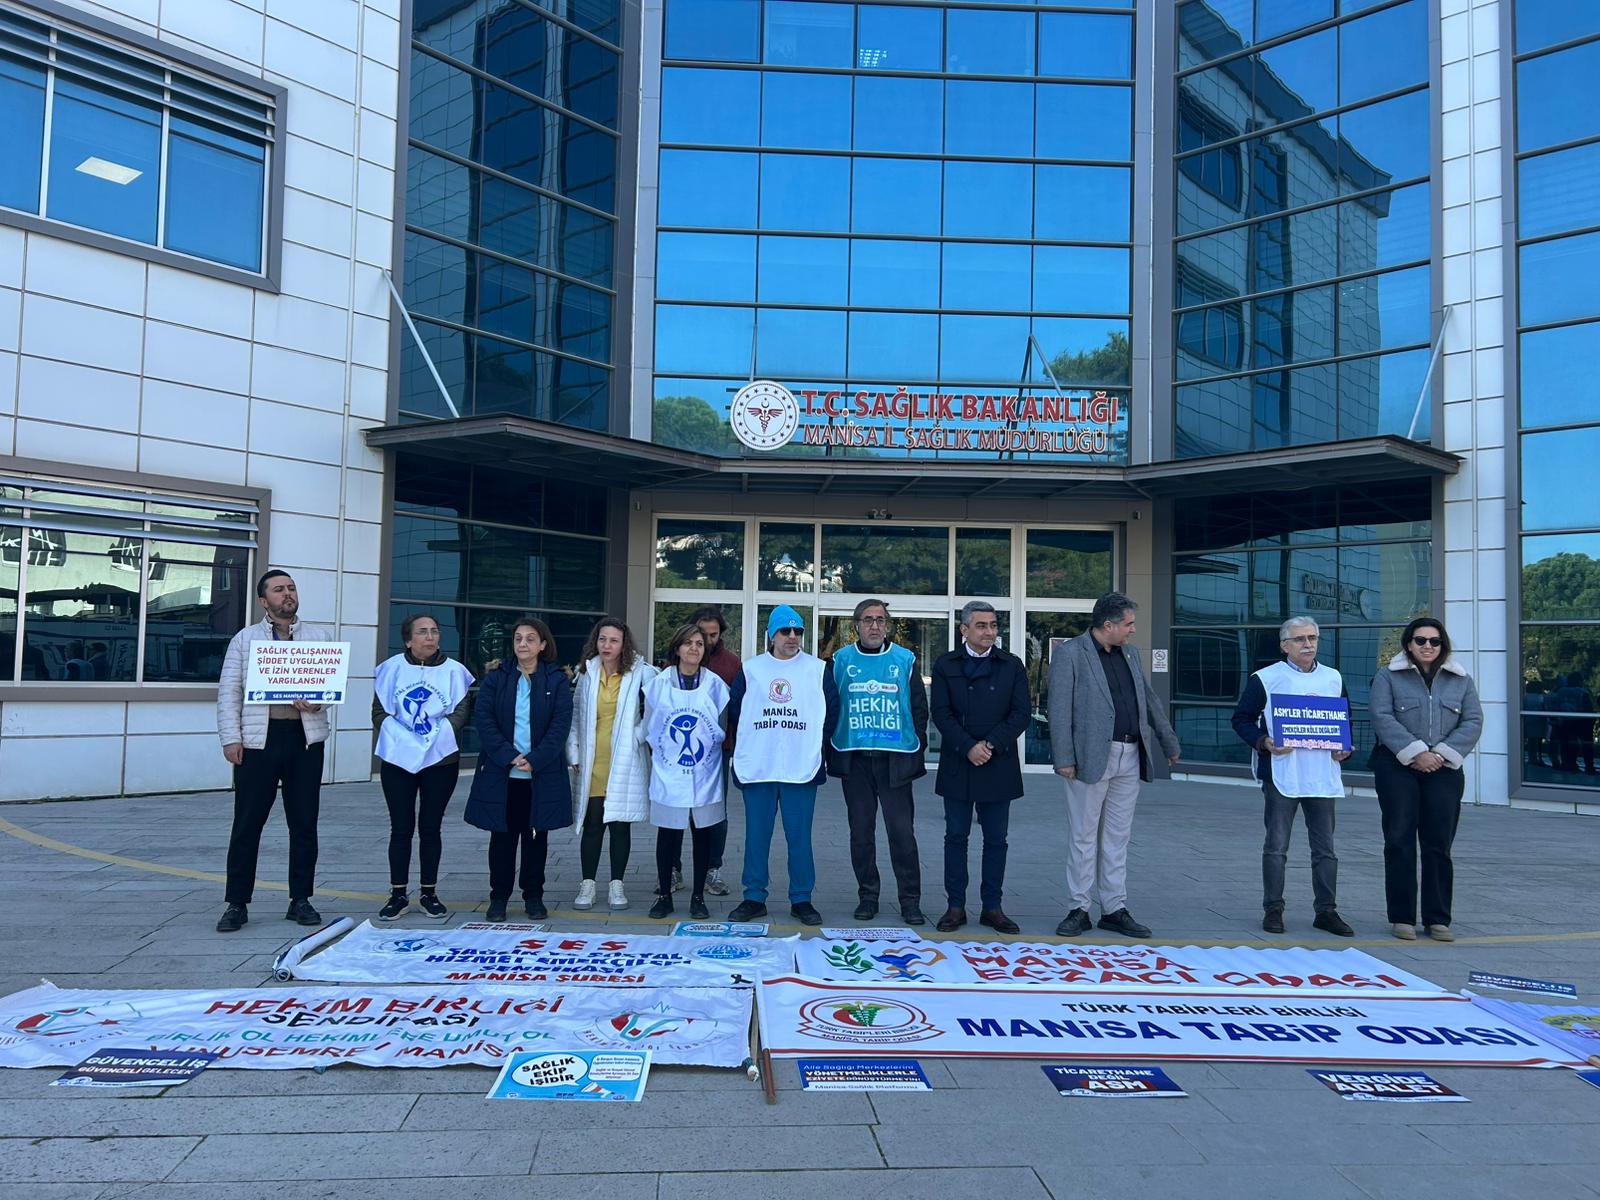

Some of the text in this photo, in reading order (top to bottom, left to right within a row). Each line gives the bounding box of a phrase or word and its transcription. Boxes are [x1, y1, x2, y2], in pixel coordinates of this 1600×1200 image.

[801, 387, 1118, 424] T.C. SAĞLIK BAKANLIĞI
[802, 421, 1105, 454] MANİSA İL SAĞLIK MÜDÜRLÜĞÜ
[256, 645, 343, 656] SAĞLIK ÇALIŞANINA
[257, 656, 341, 665] ŞİDDET UYGULAYAN
[272, 665, 290, 675] İZİN
[292, 667, 337, 675] VERENLER
[849, 695, 900, 714] HEKİM
[763, 706, 798, 718] MANİSA
[1273, 707, 1347, 720] ASM'LER TİCARETHANE
[753, 718, 779, 730] TABİP
[849, 713, 900, 730] BİRLİĞİ
[425, 955, 525, 964] HİZMET
[962, 954, 1197, 971] MANİSA
[479, 965, 625, 974] SENDİKASI
[445, 971, 646, 983] MANİSA ŞUBESİ
[972, 967, 1408, 989] ECZACI ODASI
[203, 995, 565, 1015] HEKİM BİRLİĞİ
[1061, 1002, 1368, 1018] TÜRK TABİPLERİ BİRLİĞİ
[262, 1012, 481, 1028] SENDİKASI
[241, 1030, 275, 1043] OL
[522, 1030, 556, 1041] OL
[1355, 1025, 1540, 1047] ODASI
[394, 1040, 526, 1059] MANİSA
[85, 1056, 209, 1069] GÜVENCELİ İŞ
[521, 1057, 575, 1073] SAĞLIK
[78, 1066, 143, 1074] GÜVENCELİ
[533, 1066, 568, 1078] EKİP
[1054, 1067, 1155, 1076] TİCARETHANE
[530, 1073, 575, 1086] İŞİDİR
[1088, 1080, 1148, 1090] ASM
[1318, 1073, 1434, 1085] VERGİDE
[1335, 1083, 1444, 1094] ADALET
